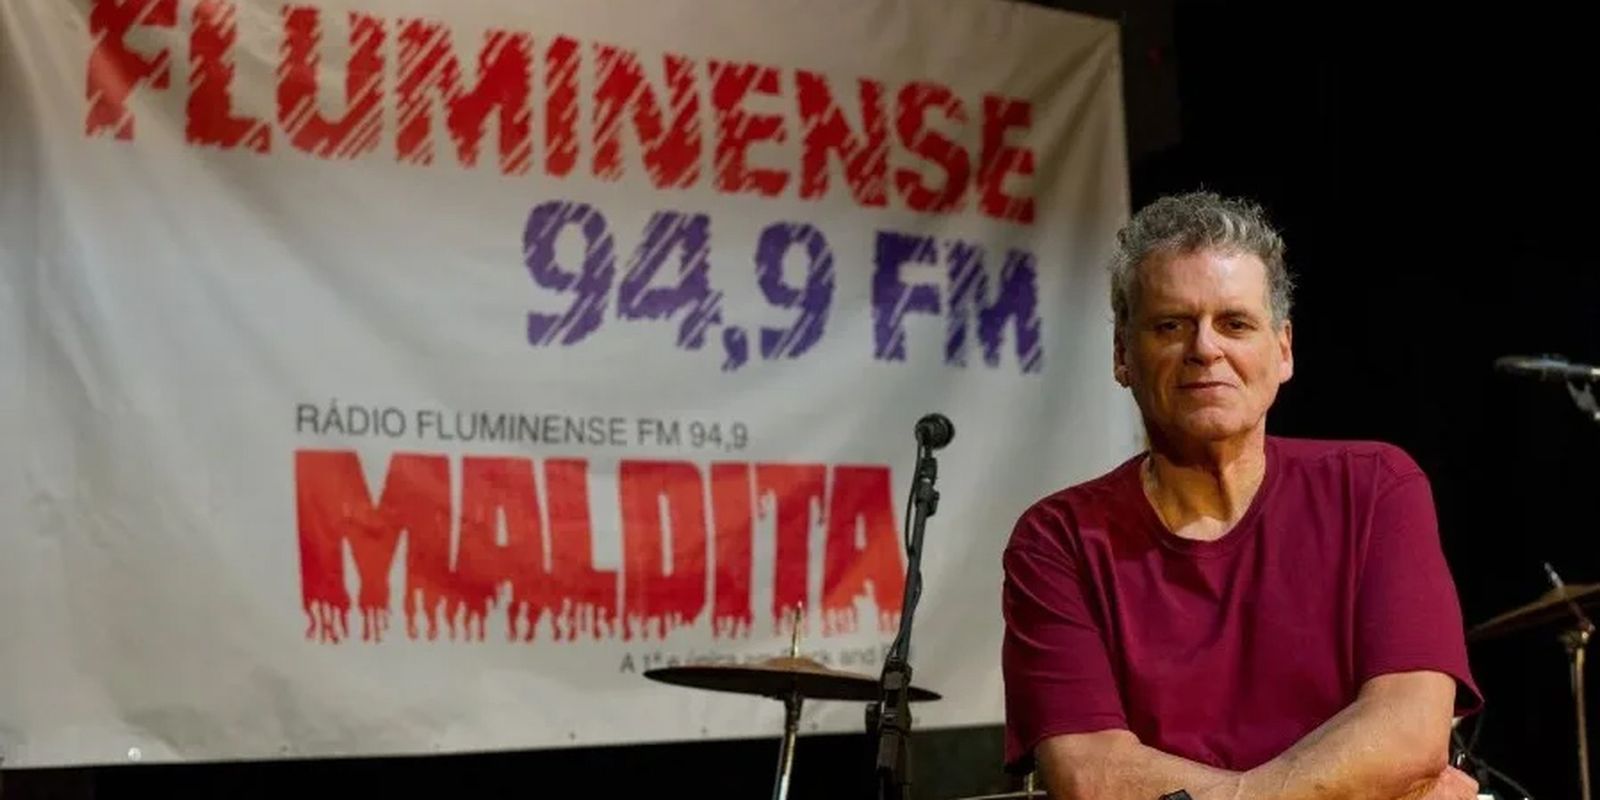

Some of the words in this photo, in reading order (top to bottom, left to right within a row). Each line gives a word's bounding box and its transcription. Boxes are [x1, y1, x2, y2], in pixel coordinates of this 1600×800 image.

[84, 0, 1036, 224] FLUMINENSE
[523, 200, 834, 371] 94,9
[871, 230, 1043, 374] FM
[295, 400, 406, 438] RÁDIO
[417, 410, 627, 446] FLUMINENSE
[638, 419, 681, 447] FM
[689, 420, 749, 451] 94,9
[295, 449, 906, 644] MALDITA
